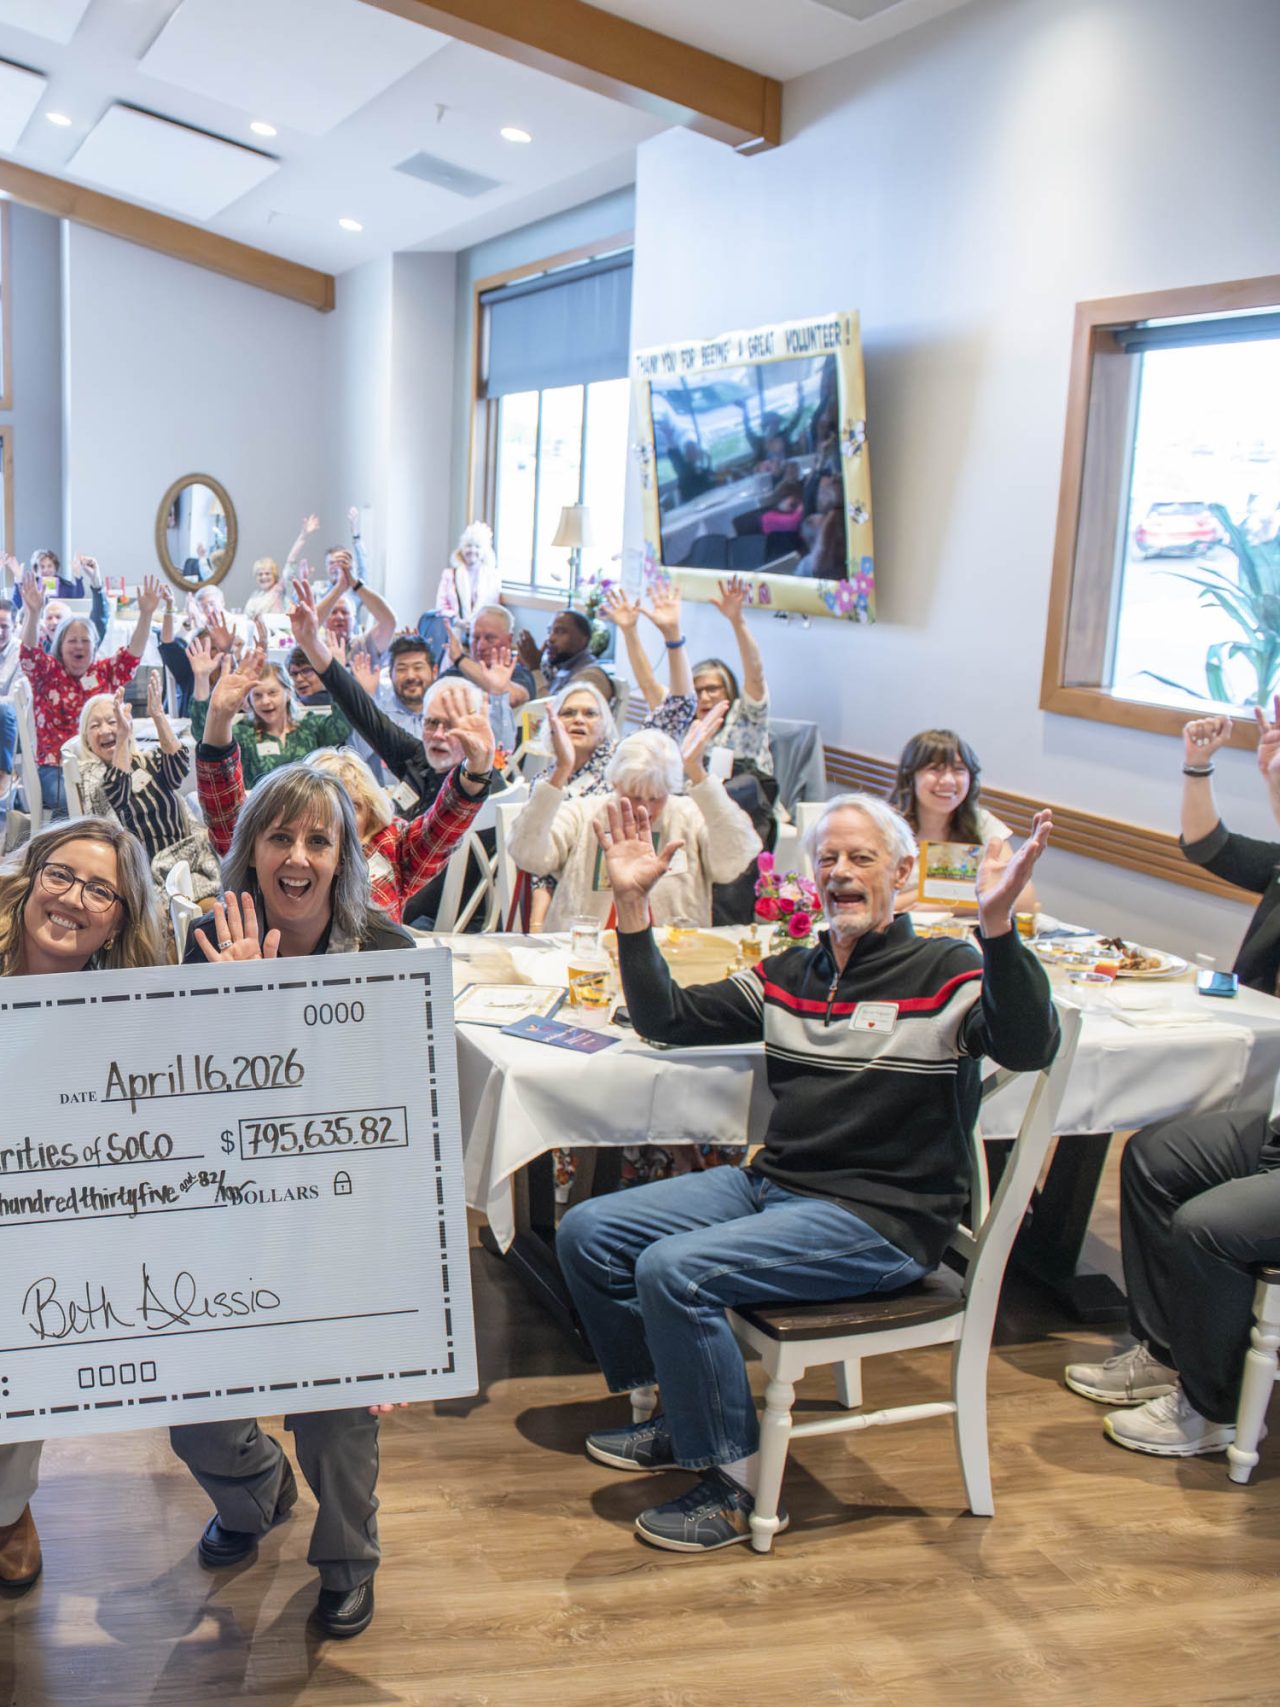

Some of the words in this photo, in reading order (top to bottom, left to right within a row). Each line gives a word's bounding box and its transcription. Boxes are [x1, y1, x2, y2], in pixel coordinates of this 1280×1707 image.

[661, 350, 676, 373] YOU
[748, 331, 774, 358] GREAT
[304, 1001, 365, 1026] 0000
[59, 1091, 97, 1105] DATE
[106, 1054, 185, 1115] April
[83, 1136, 101, 1168] of
[231, 1184, 319, 1206] DOLLARS
